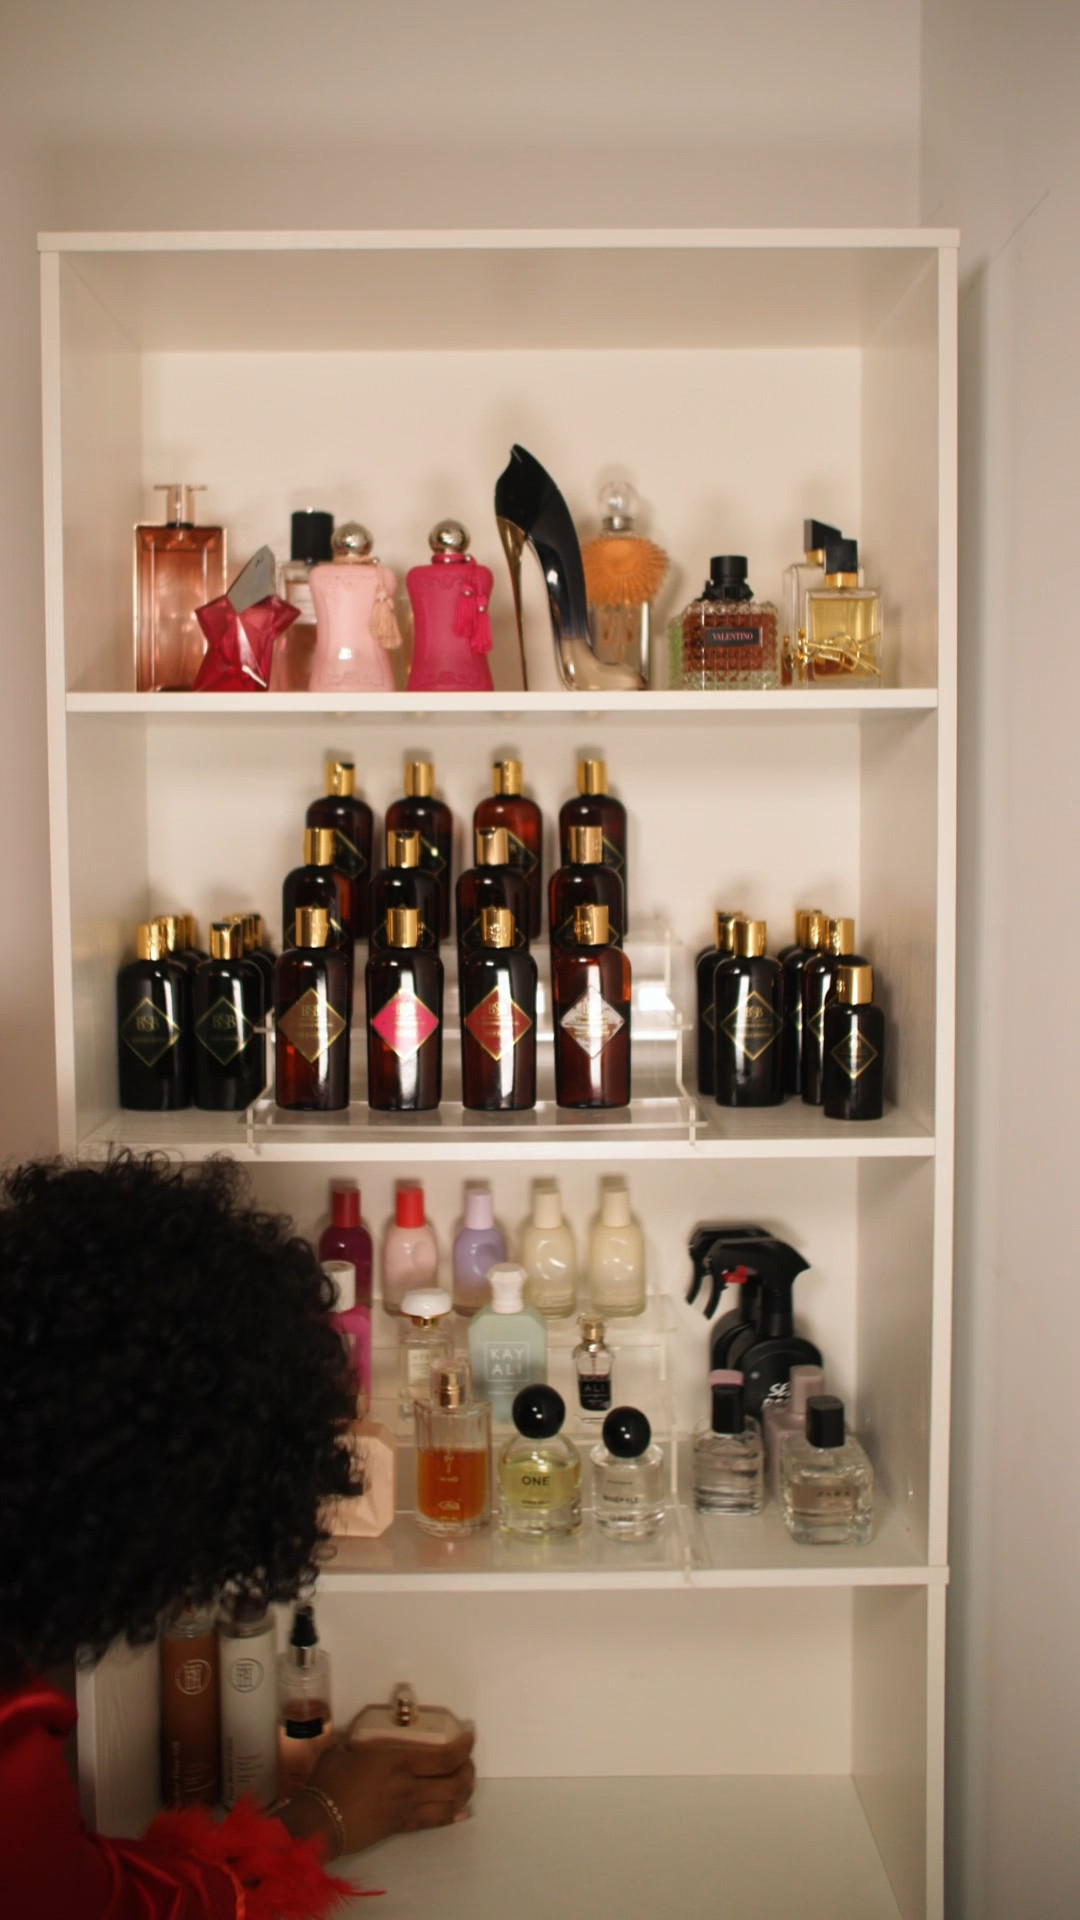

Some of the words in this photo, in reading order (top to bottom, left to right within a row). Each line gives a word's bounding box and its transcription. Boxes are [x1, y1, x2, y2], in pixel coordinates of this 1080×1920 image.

[712, 632, 754, 641] VALENTINO
[491, 1348, 524, 1360] KAY
[492, 1364, 521, 1375] ALI
[768, 1383, 791, 1397] SE
[521, 1475, 550, 1486] ONE
